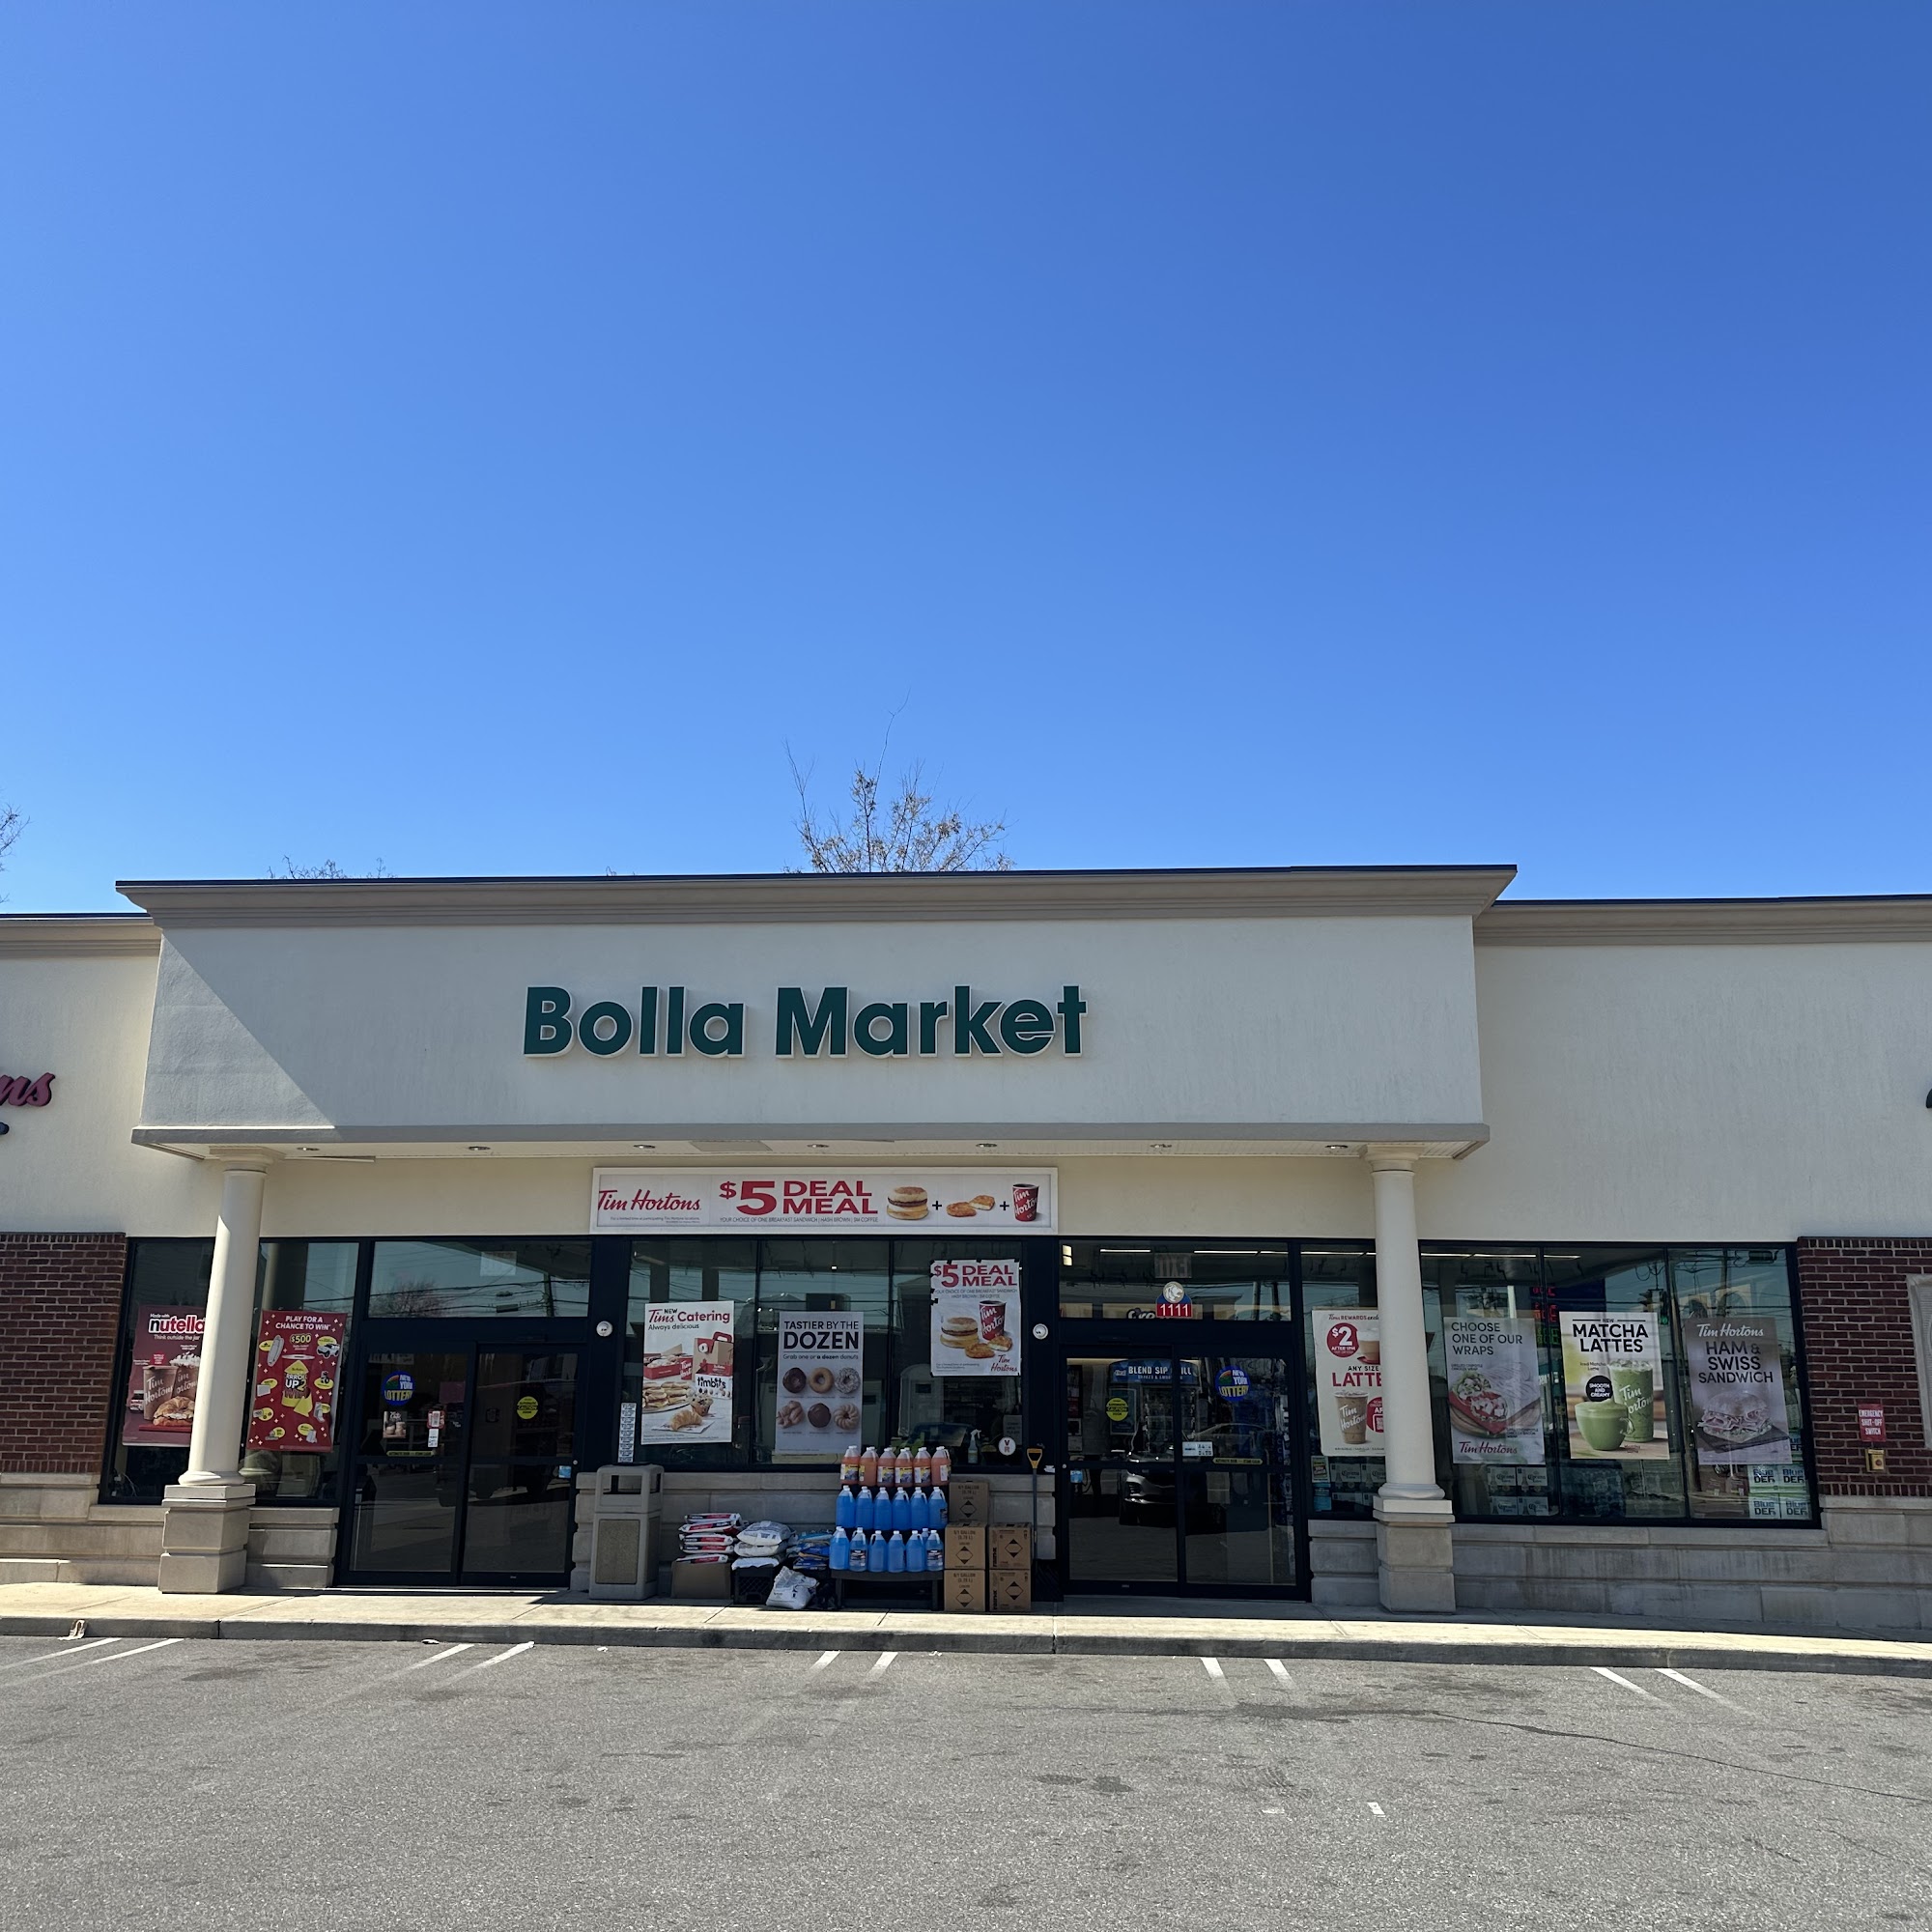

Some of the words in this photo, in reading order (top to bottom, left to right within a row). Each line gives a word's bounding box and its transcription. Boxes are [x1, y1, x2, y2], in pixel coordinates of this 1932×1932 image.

[524, 985, 746, 1057] Bolla
[775, 985, 1088, 1058] Market
[598, 1189, 627, 1210] Tim
[631, 1188, 701, 1210] Hortons
[719, 1180, 778, 1215] $5
[783, 1180, 872, 1197] DEAL
[782, 1199, 878, 1214] MEAL
[934, 1264, 959, 1288] $5
[962, 1264, 1014, 1275] DEAL
[962, 1276, 1017, 1287] MEAL
[648, 1309, 674, 1323] Tims
[678, 1310, 730, 1323] Catering
[1160, 1304, 1189, 1317] 1111
[149, 1315, 206, 1333] nutella
[784, 1321, 824, 1330] TASTIER
[827, 1321, 839, 1330] BY
[840, 1321, 859, 1330] THE
[1451, 1322, 1501, 1332] CHOOSE
[1697, 1323, 1719, 1338] Tim
[1719, 1323, 1764, 1337] Hortons
[1332, 1326, 1353, 1347] $2
[1573, 1324, 1649, 1338] MATCHA
[291, 1335, 311, 1344] $500
[783, 1331, 859, 1350] DOZEN
[1452, 1334, 1477, 1344] ONE
[1479, 1334, 1495, 1344] OF
[1497, 1335, 1522, 1345] OUR
[1580, 1339, 1644, 1352] LATTES
[1453, 1346, 1494, 1355] WRAPS
[1706, 1342, 1747, 1355] HAM
[1750, 1344, 1761, 1354] &
[998, 1354, 1010, 1364] Tim
[1708, 1356, 1761, 1371] SWISS
[991, 1362, 1018, 1372] Hortons
[1128, 1366, 1152, 1375] BLEND
[146, 1377, 163, 1390] Tim
[286, 1379, 299, 1389] UP
[697, 1377, 726, 1389] timbits
[1233, 1377, 1248, 1385] YORK
[1698, 1372, 1774, 1384] SANDWICH
[400, 1381, 413, 1390] YORK
[1218, 1385, 1249, 1398] LOTTERY
[384, 1390, 413, 1402] LOTTERY
[1619, 1385, 1642, 1401] Tim
[1340, 1405, 1358, 1418] Tim
[1459, 1441, 1478, 1454] Tim
[1479, 1441, 1518, 1454] Hortons
